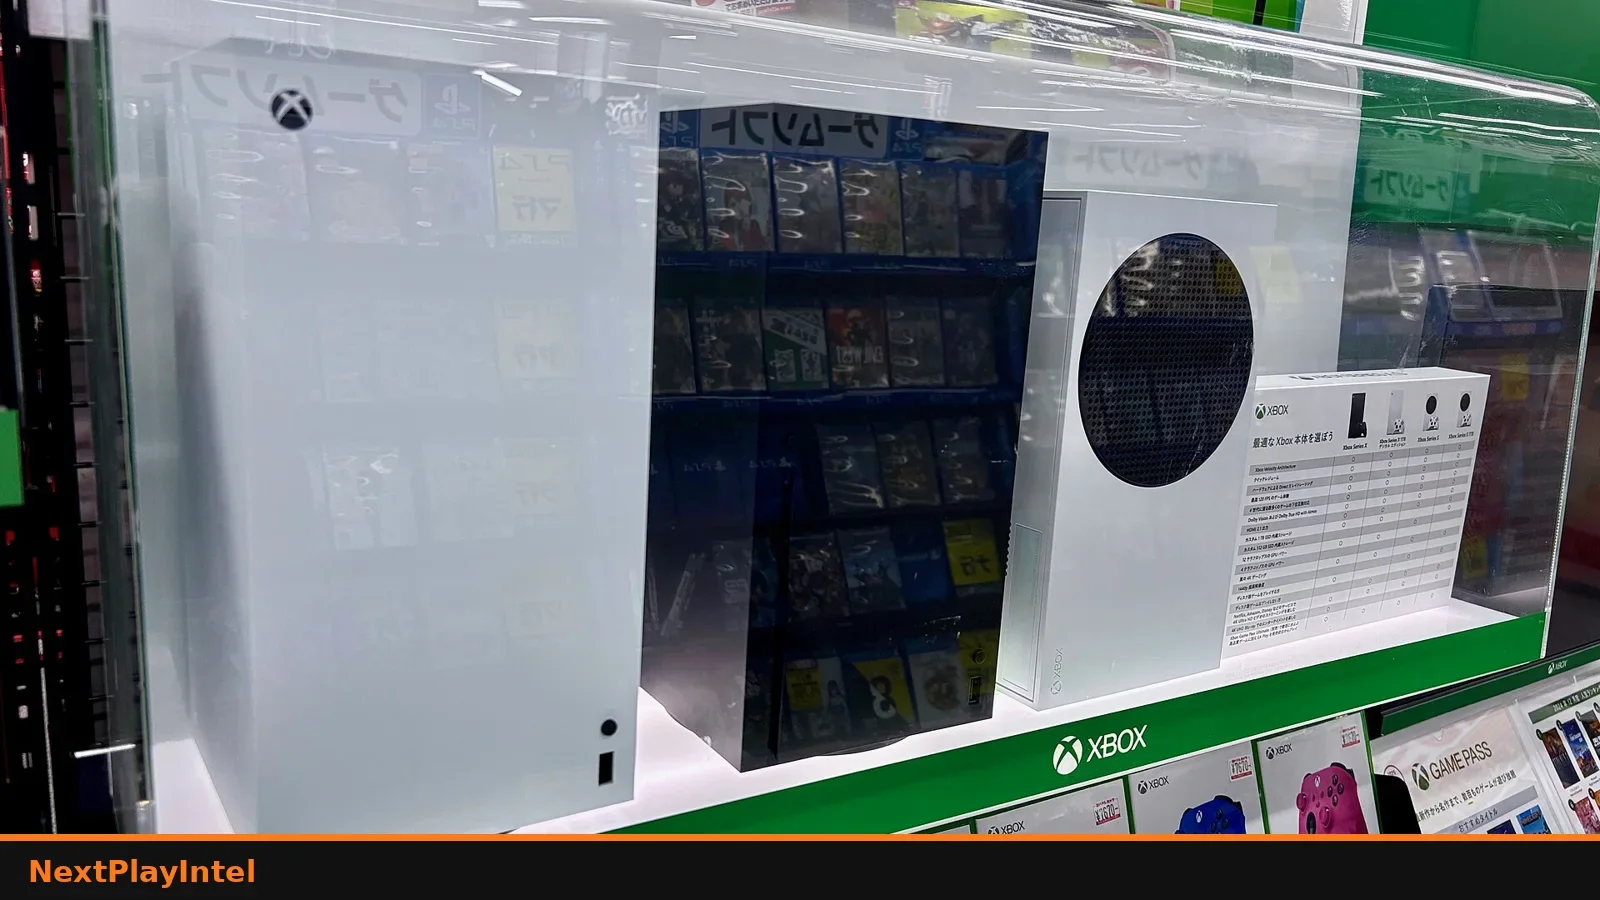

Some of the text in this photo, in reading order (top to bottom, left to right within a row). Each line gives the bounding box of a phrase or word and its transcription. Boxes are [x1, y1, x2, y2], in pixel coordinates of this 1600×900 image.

[1267, 404, 1289, 416] XBOX
[1276, 436, 1293, 446] Xbox
[1053, 647, 1064, 678] XBOX
[1086, 725, 1148, 763] XBOX
[1275, 743, 1293, 757] XBOX
[1429, 741, 1493, 780] GAME PASS
[1148, 775, 1169, 791] XBOX
[1000, 821, 1025, 834] XBOX
[1458, 808, 1498, 833] おすすめタイトル
